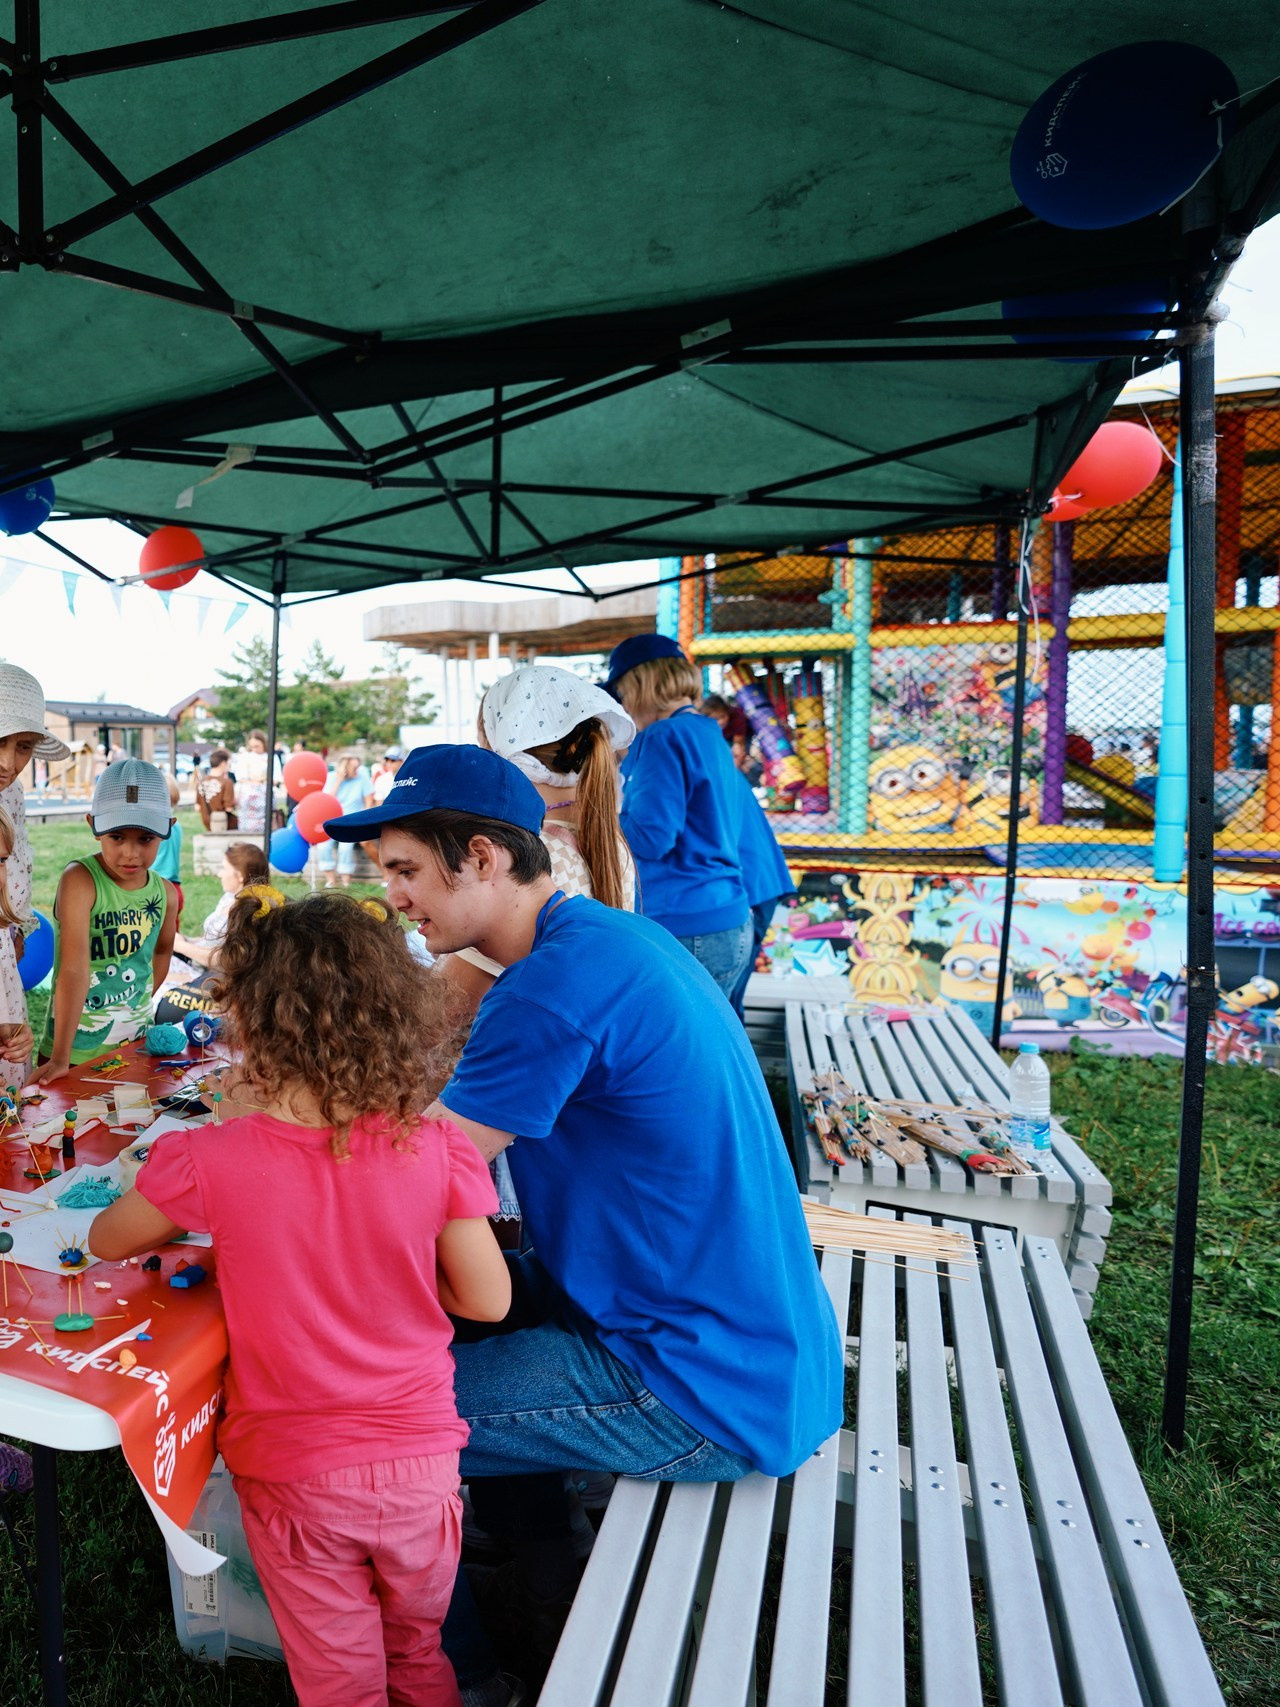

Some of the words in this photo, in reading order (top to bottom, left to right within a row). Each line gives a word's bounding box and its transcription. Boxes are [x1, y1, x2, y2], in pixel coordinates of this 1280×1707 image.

[95, 909, 142, 929] HANGRY
[90, 928, 141, 961] ATOR
[25, 1340, 170, 1418] КИДСПЕЙС
